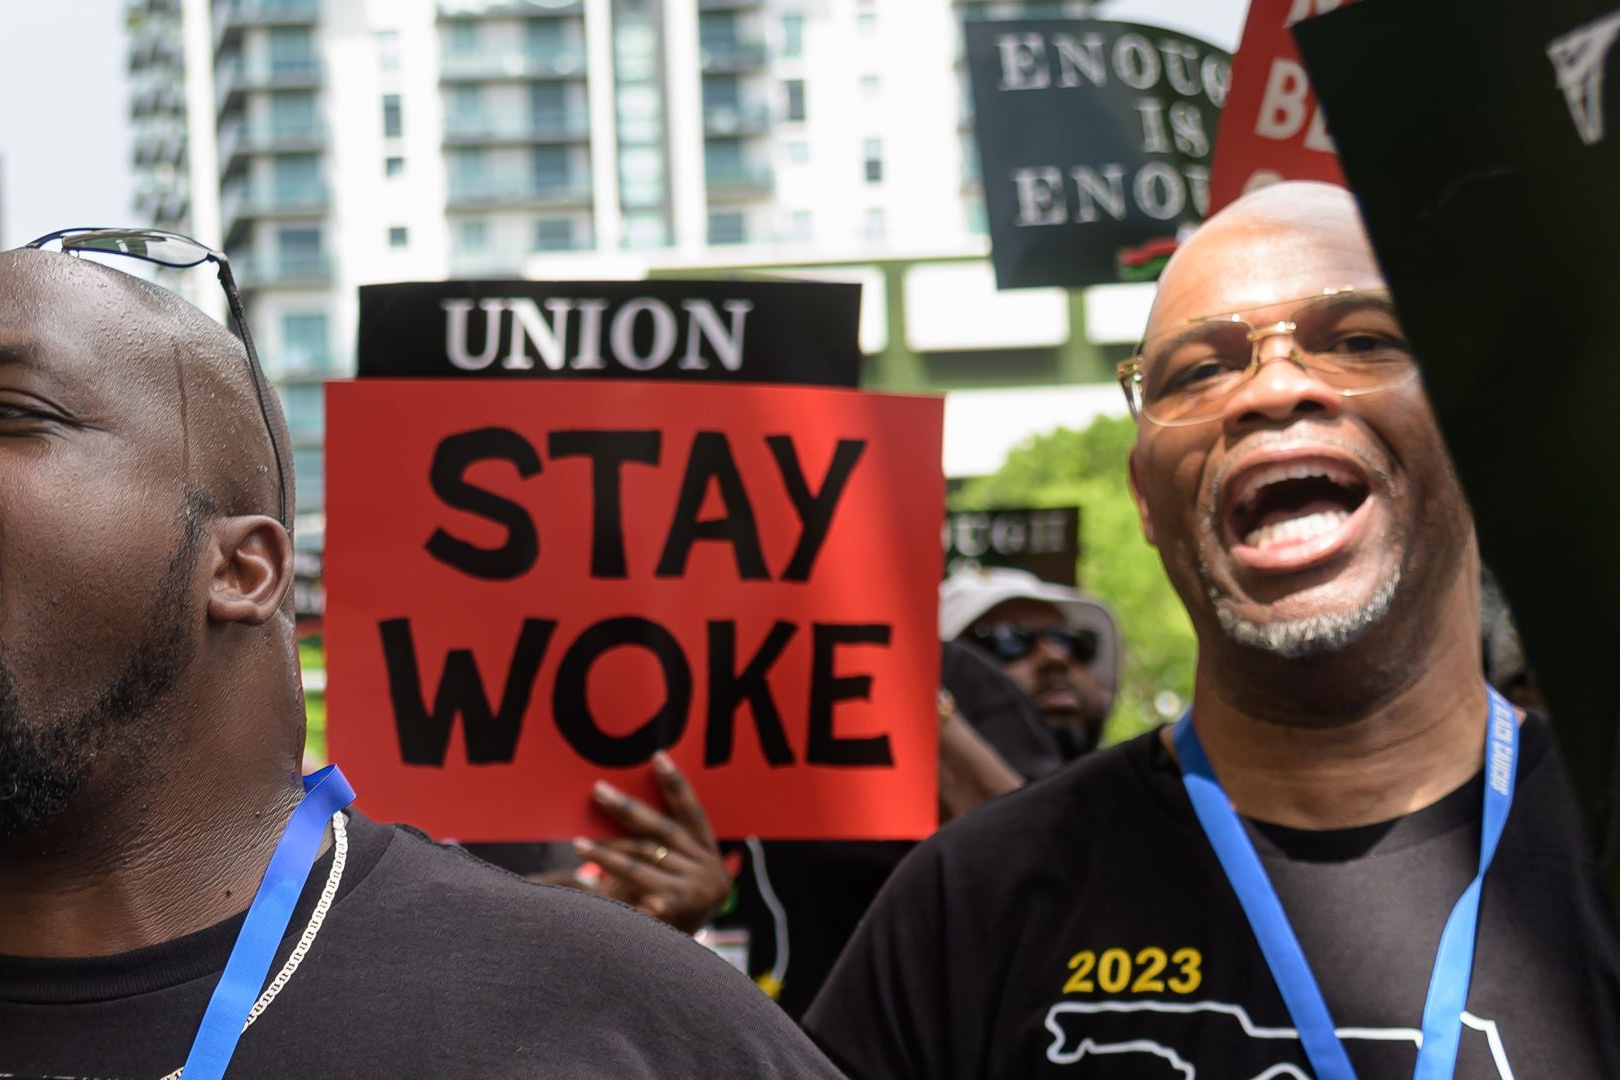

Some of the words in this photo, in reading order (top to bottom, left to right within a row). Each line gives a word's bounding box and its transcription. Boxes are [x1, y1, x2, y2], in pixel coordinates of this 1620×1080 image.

[995, 32, 1233, 108] ENOUG
[1136, 98, 1210, 158] IS
[441, 296, 754, 371] UNION
[423, 426, 869, 585] STAY
[377, 615, 896, 770] WOKE
[1062, 947, 1203, 995] 2023
